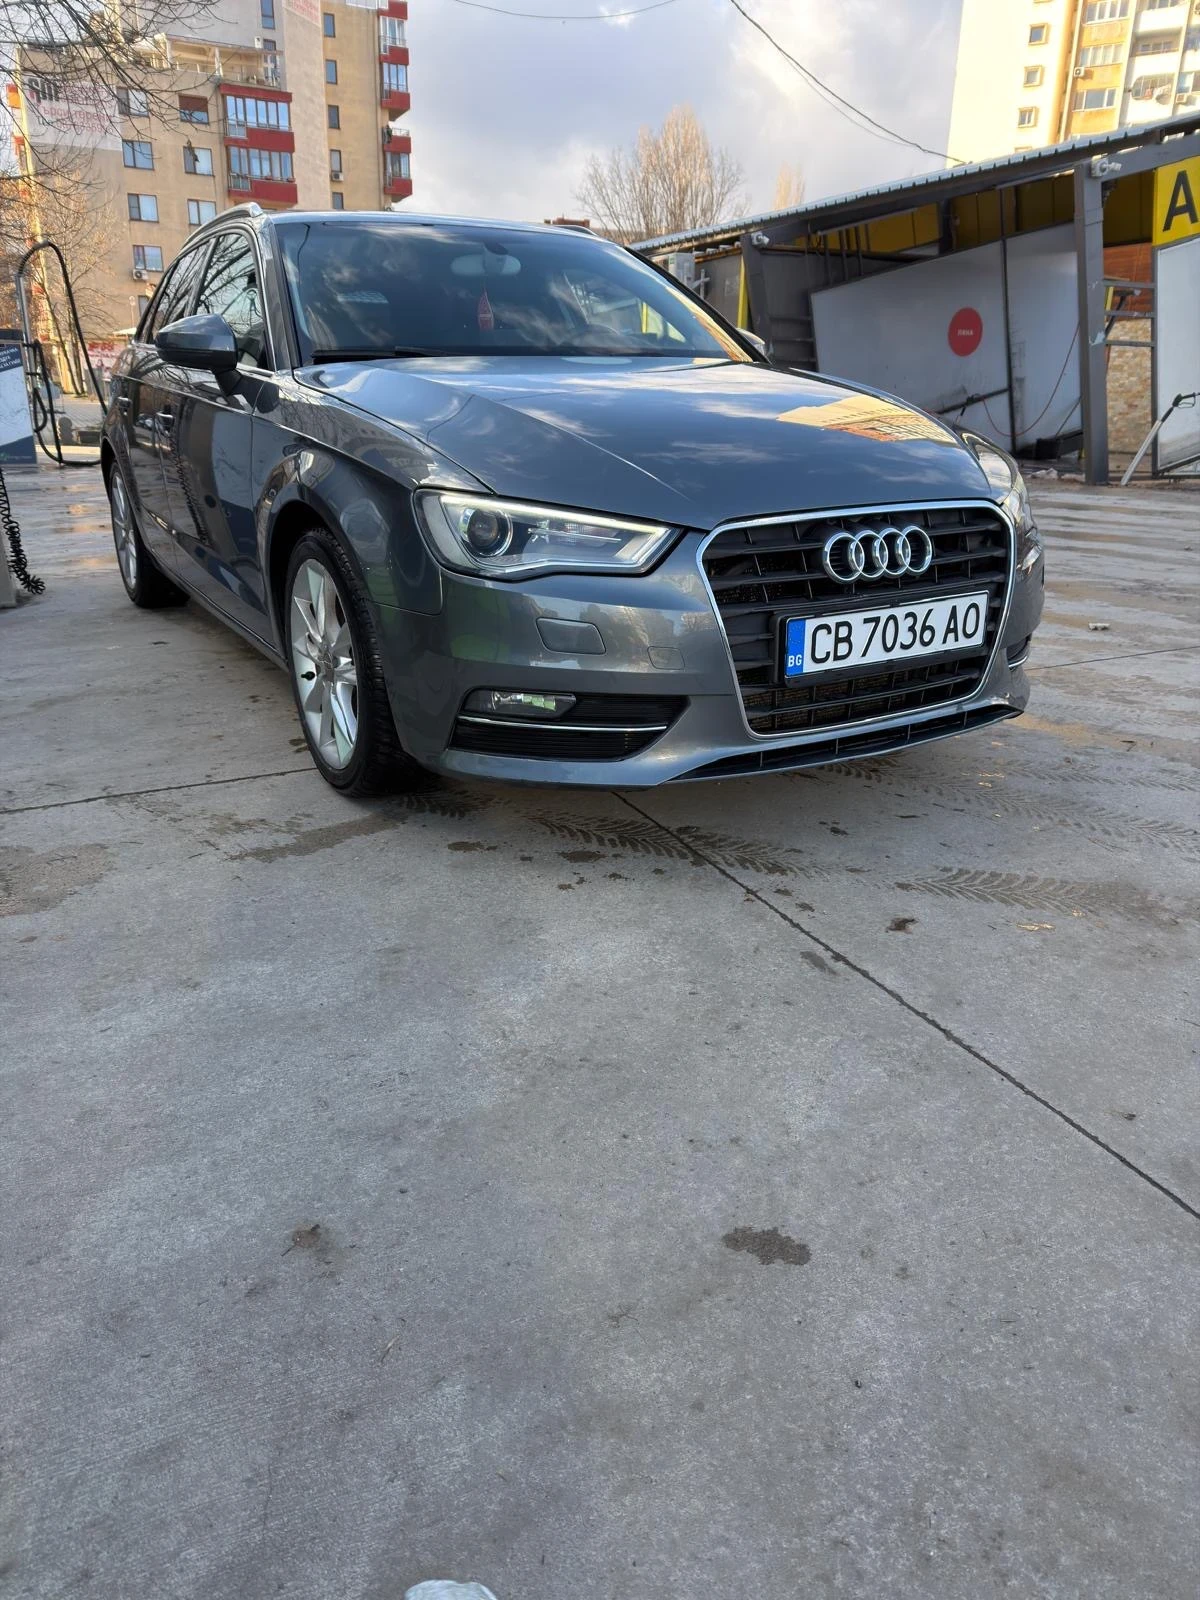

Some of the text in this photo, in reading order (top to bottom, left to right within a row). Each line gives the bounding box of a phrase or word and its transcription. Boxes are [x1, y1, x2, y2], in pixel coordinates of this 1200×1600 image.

[1163, 170, 1199, 232] A
[787, 654, 803, 668] BG
[810, 602, 981, 664] CB 7036 AO
